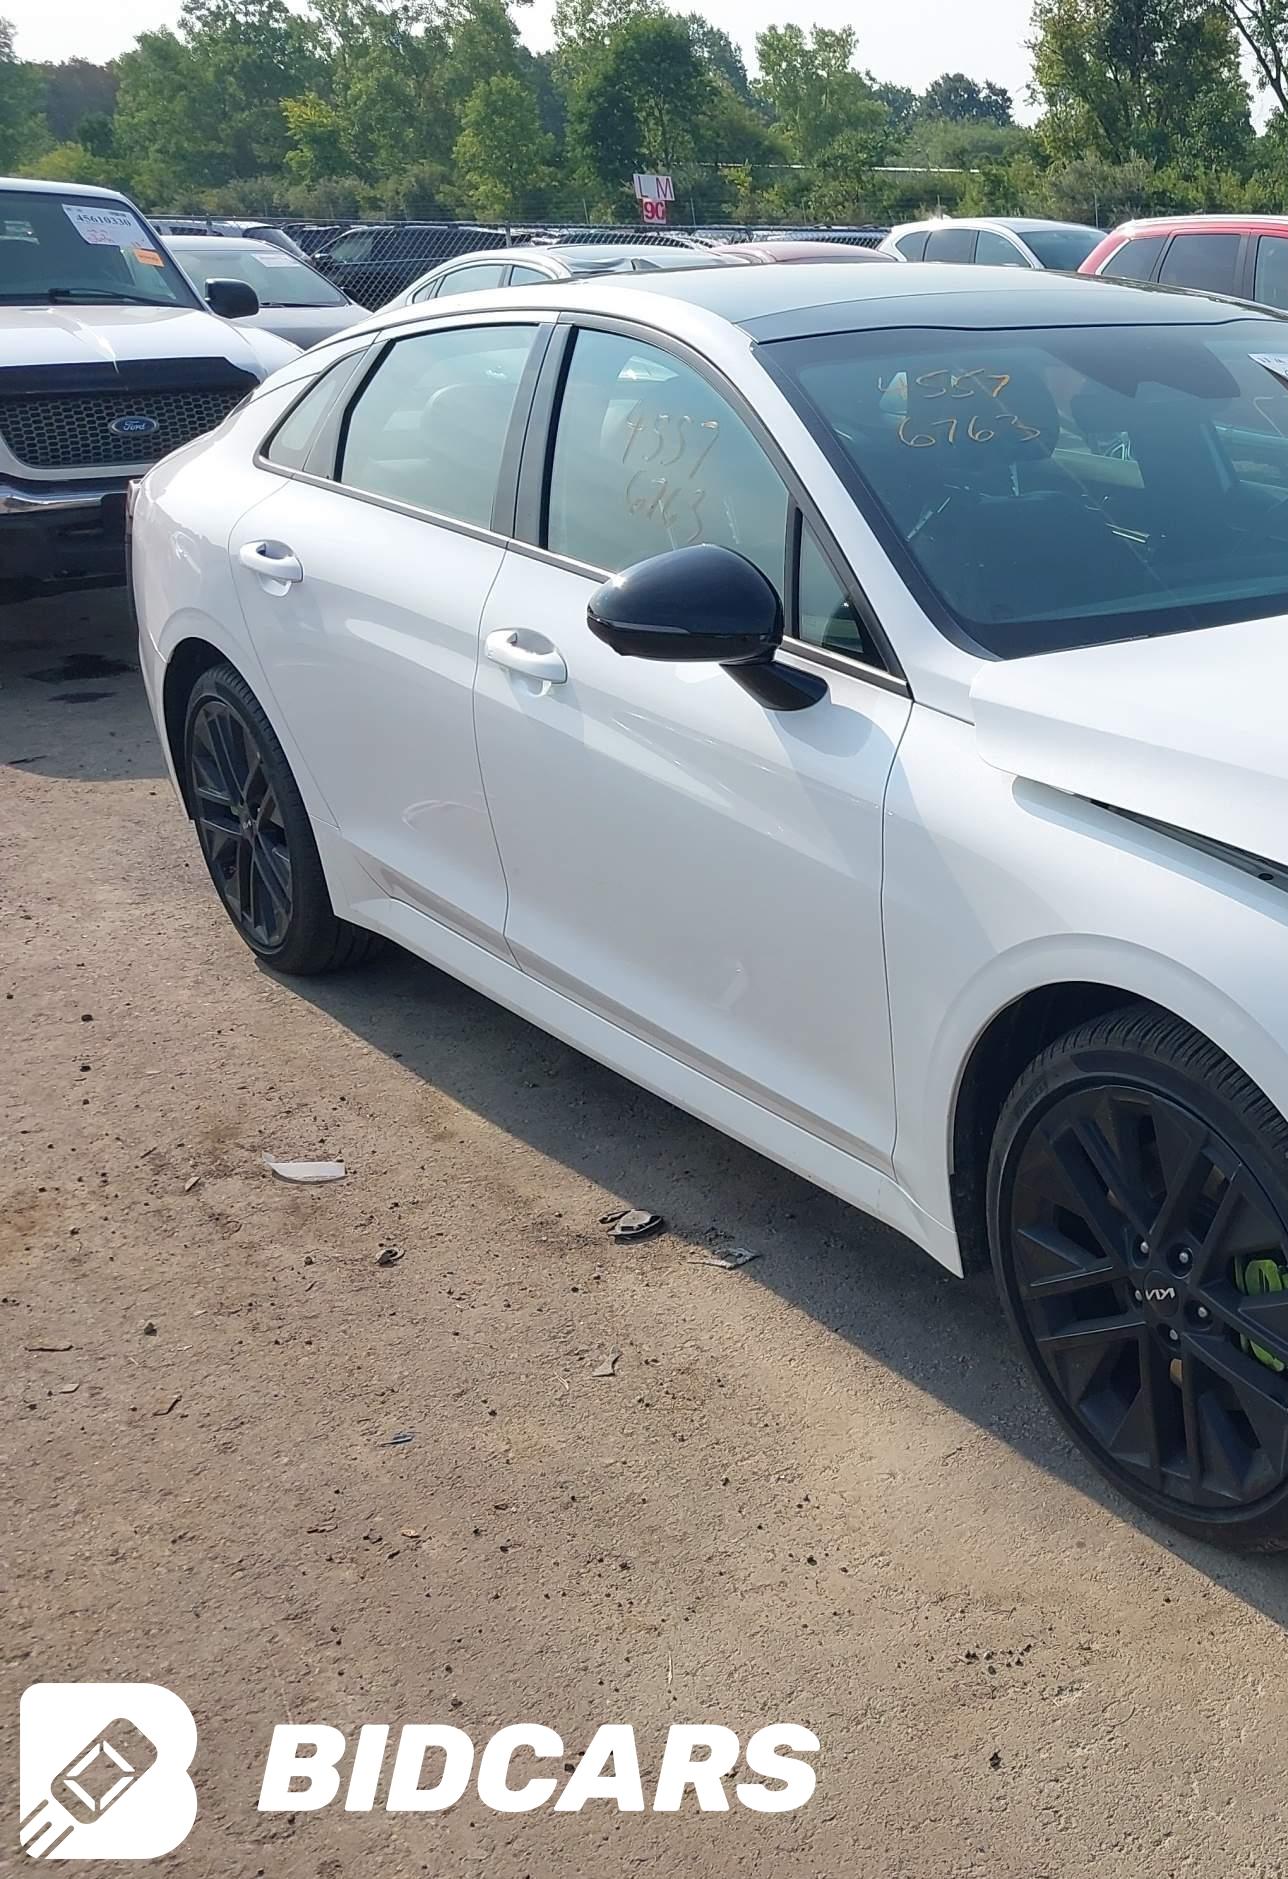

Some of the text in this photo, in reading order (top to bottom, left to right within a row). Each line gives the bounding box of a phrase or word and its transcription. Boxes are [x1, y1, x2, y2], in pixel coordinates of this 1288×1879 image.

[878, 368, 1010, 398] 4557
[123, 420, 145, 430] Ford
[898, 414, 1041, 447] 6763
